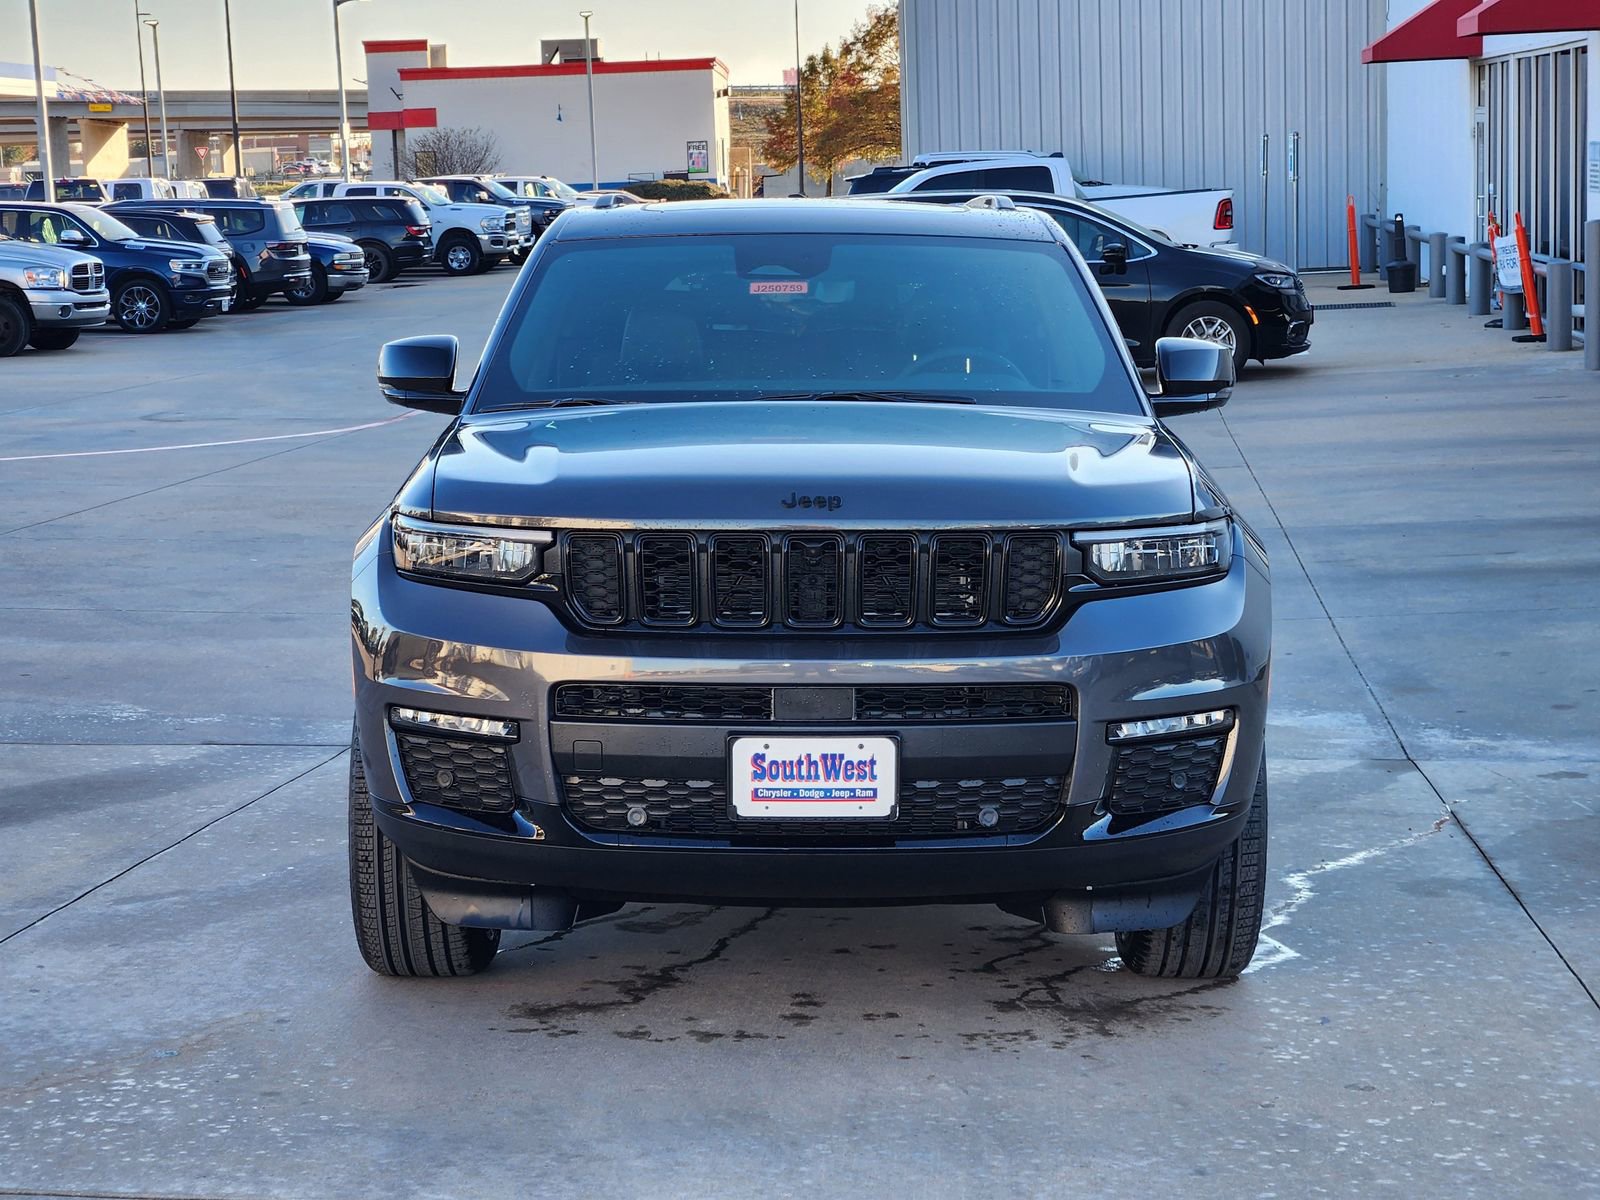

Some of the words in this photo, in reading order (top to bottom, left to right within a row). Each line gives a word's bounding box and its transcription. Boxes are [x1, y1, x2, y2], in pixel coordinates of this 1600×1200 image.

[753, 284, 803, 293] J250759
[781, 492, 843, 511] Jeep
[751, 752, 878, 782] SouthWest
[757, 788, 791, 798] Chrysler
[799, 788, 824, 798] Dodge
[831, 788, 850, 798] Jeep
[855, 788, 873, 797] Ram
